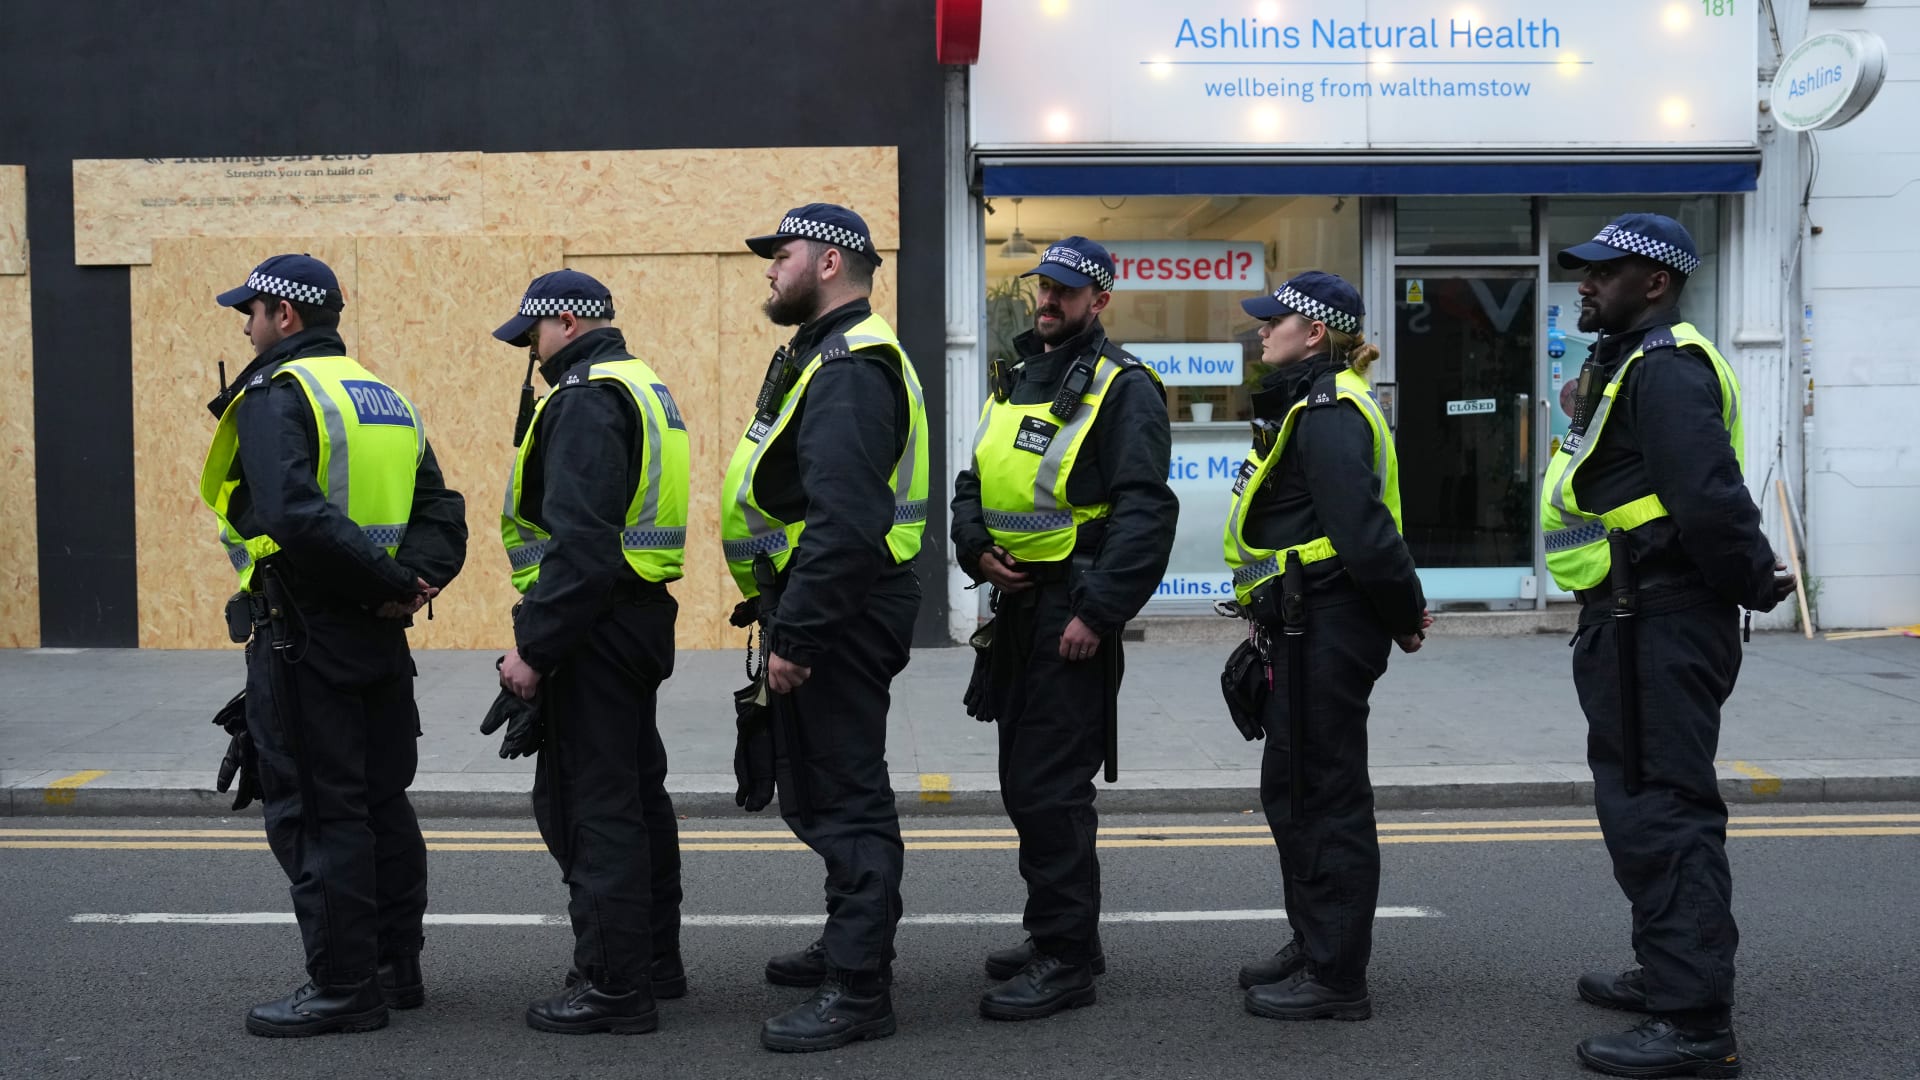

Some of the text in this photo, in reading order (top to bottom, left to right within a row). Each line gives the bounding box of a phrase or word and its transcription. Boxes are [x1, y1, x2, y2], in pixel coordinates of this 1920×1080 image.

[1702, 0, 1735, 17] 181
[1174, 17, 1561, 49] Ashlins Natural Health
[1204, 77, 1531, 103] wellbeing from walthamstow
[1788, 64, 1842, 100] Ashlins
[226, 166, 374, 179] Strength you can build on
[1188, 355, 1234, 374] Now
[348, 386, 411, 419] POLICE
[1449, 402, 1494, 412] CLOSED
[1153, 578, 1232, 595] hlins.c
